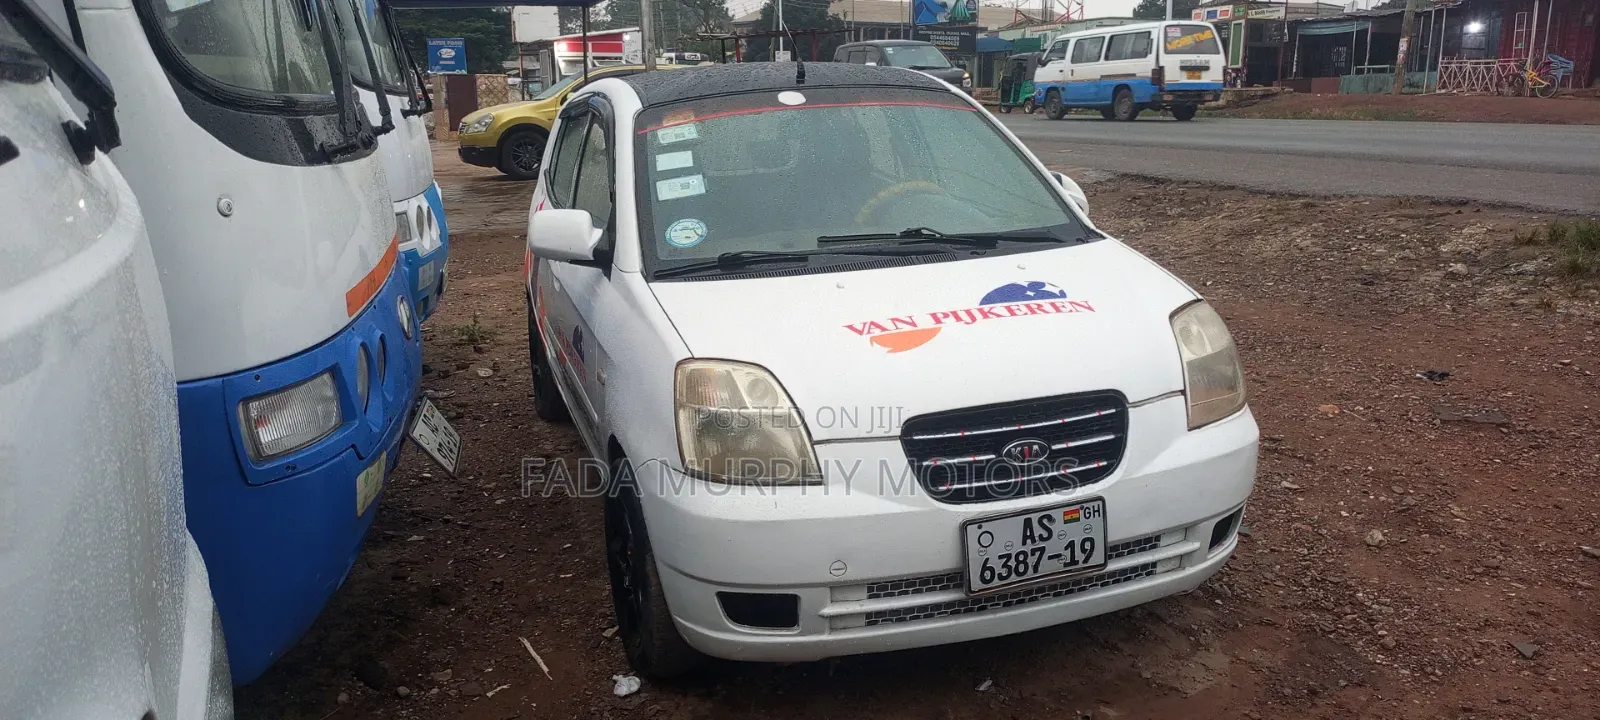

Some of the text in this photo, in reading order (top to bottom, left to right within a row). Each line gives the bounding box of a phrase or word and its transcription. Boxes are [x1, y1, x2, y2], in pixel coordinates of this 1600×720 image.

[841, 300, 1097, 336] VAN PIJKEREN
[1010, 444, 1043, 461] KIA
[1021, 504, 1101, 546] AS GH
[978, 536, 1096, 585] 6387-19
